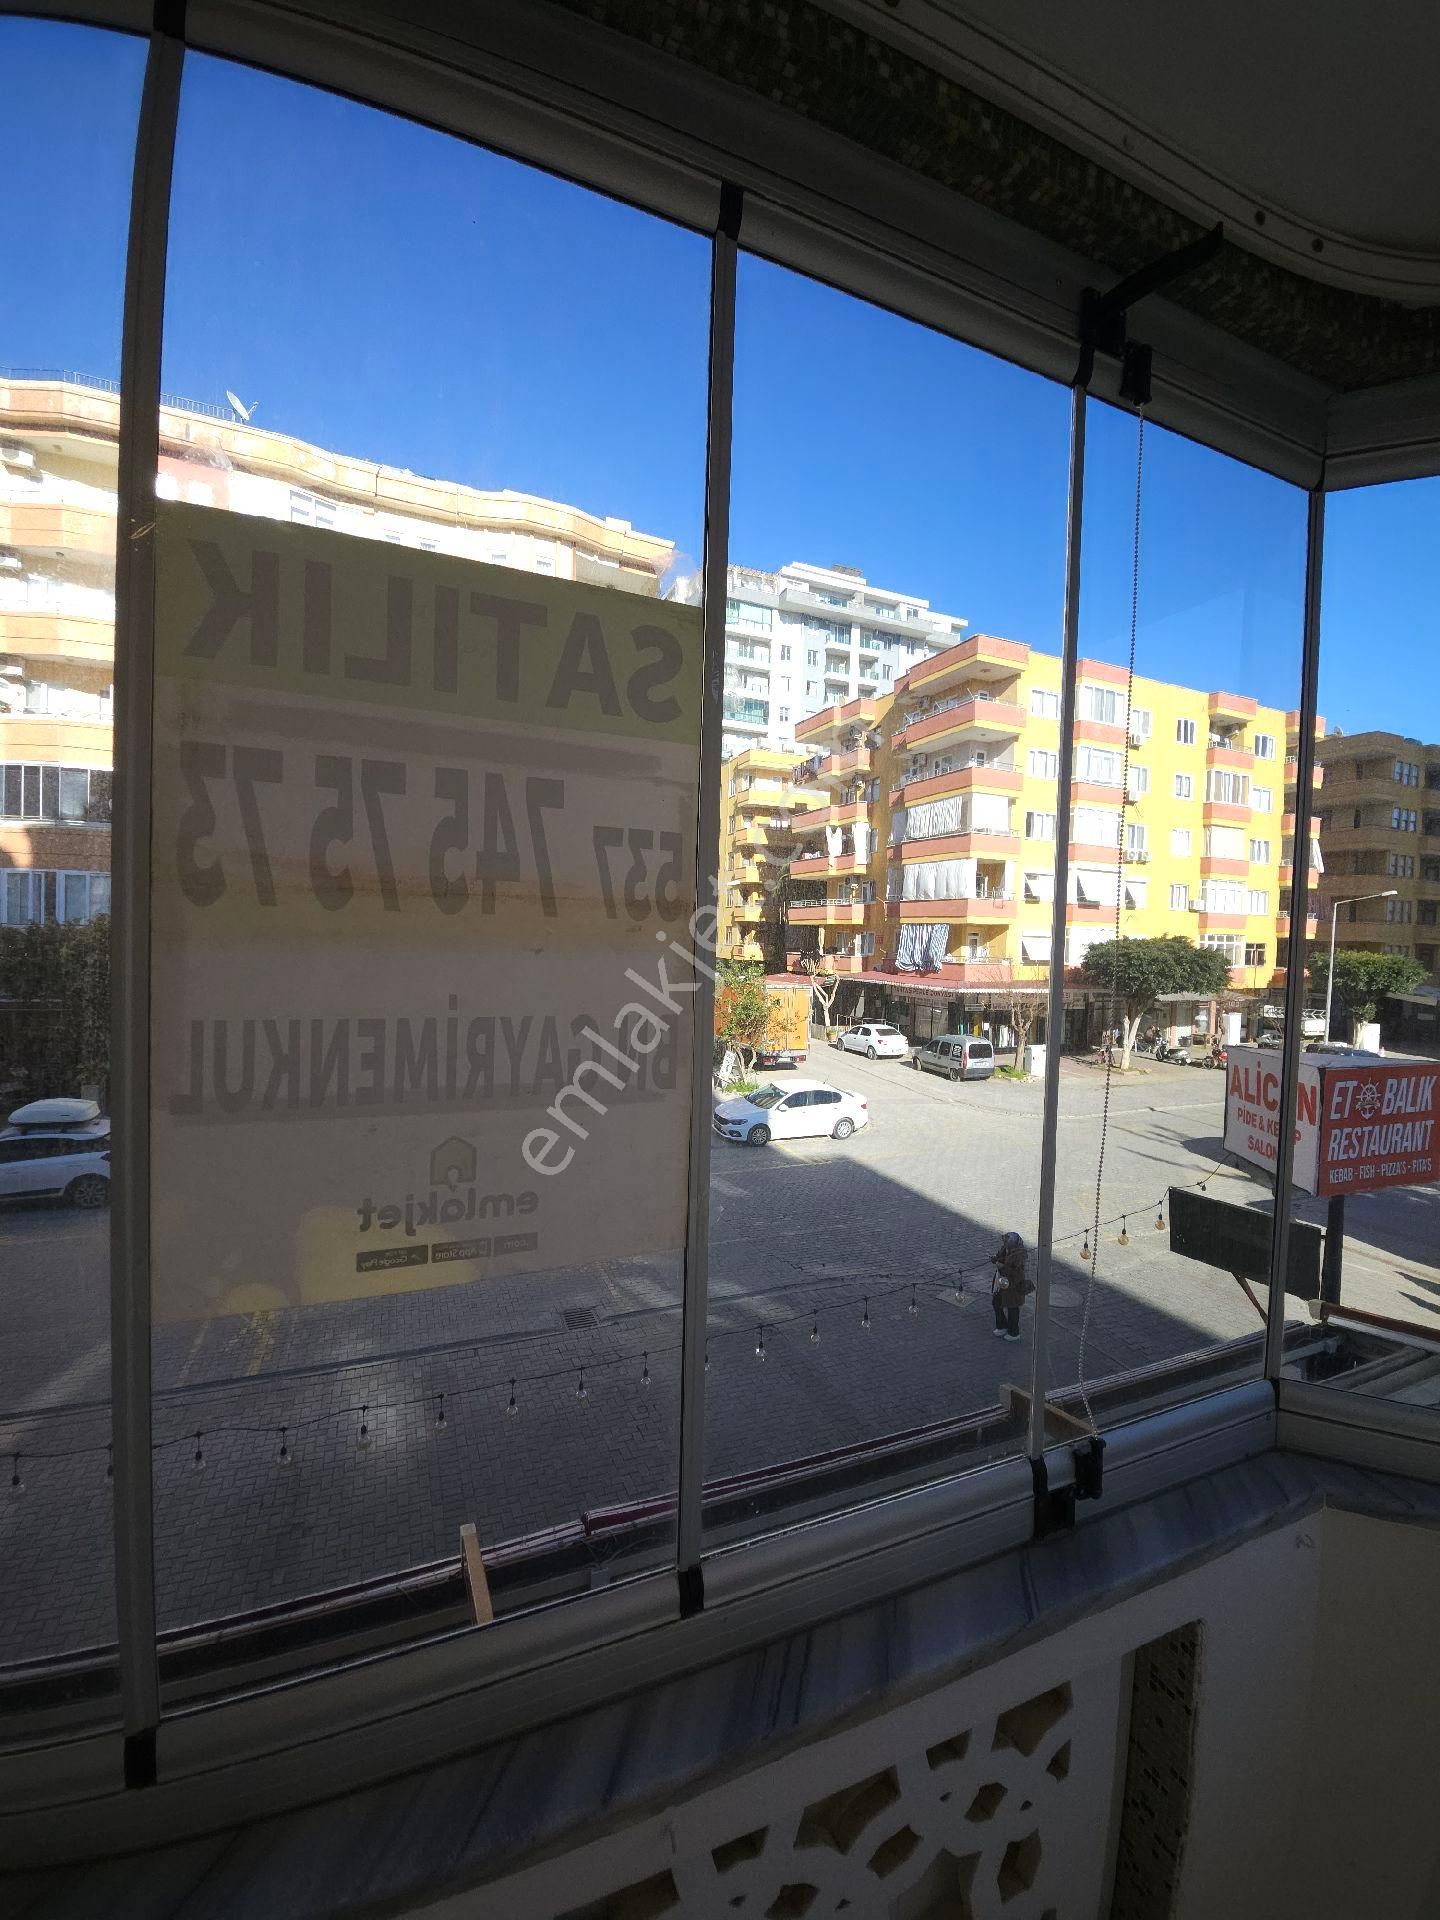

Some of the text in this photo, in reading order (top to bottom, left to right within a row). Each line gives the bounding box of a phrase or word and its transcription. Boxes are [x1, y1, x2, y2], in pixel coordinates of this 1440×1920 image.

[1230, 1061, 1317, 1126] ALİCN
[1330, 1076, 1437, 1120] ET BALIK
[1238, 1105, 1257, 1128] PİDE
[1259, 1121, 1265, 1131] &
[1327, 1120, 1435, 1162] RESTAURANT
[1329, 1166, 1353, 1184] KEBAB
[1359, 1165, 1375, 1180] FISH
